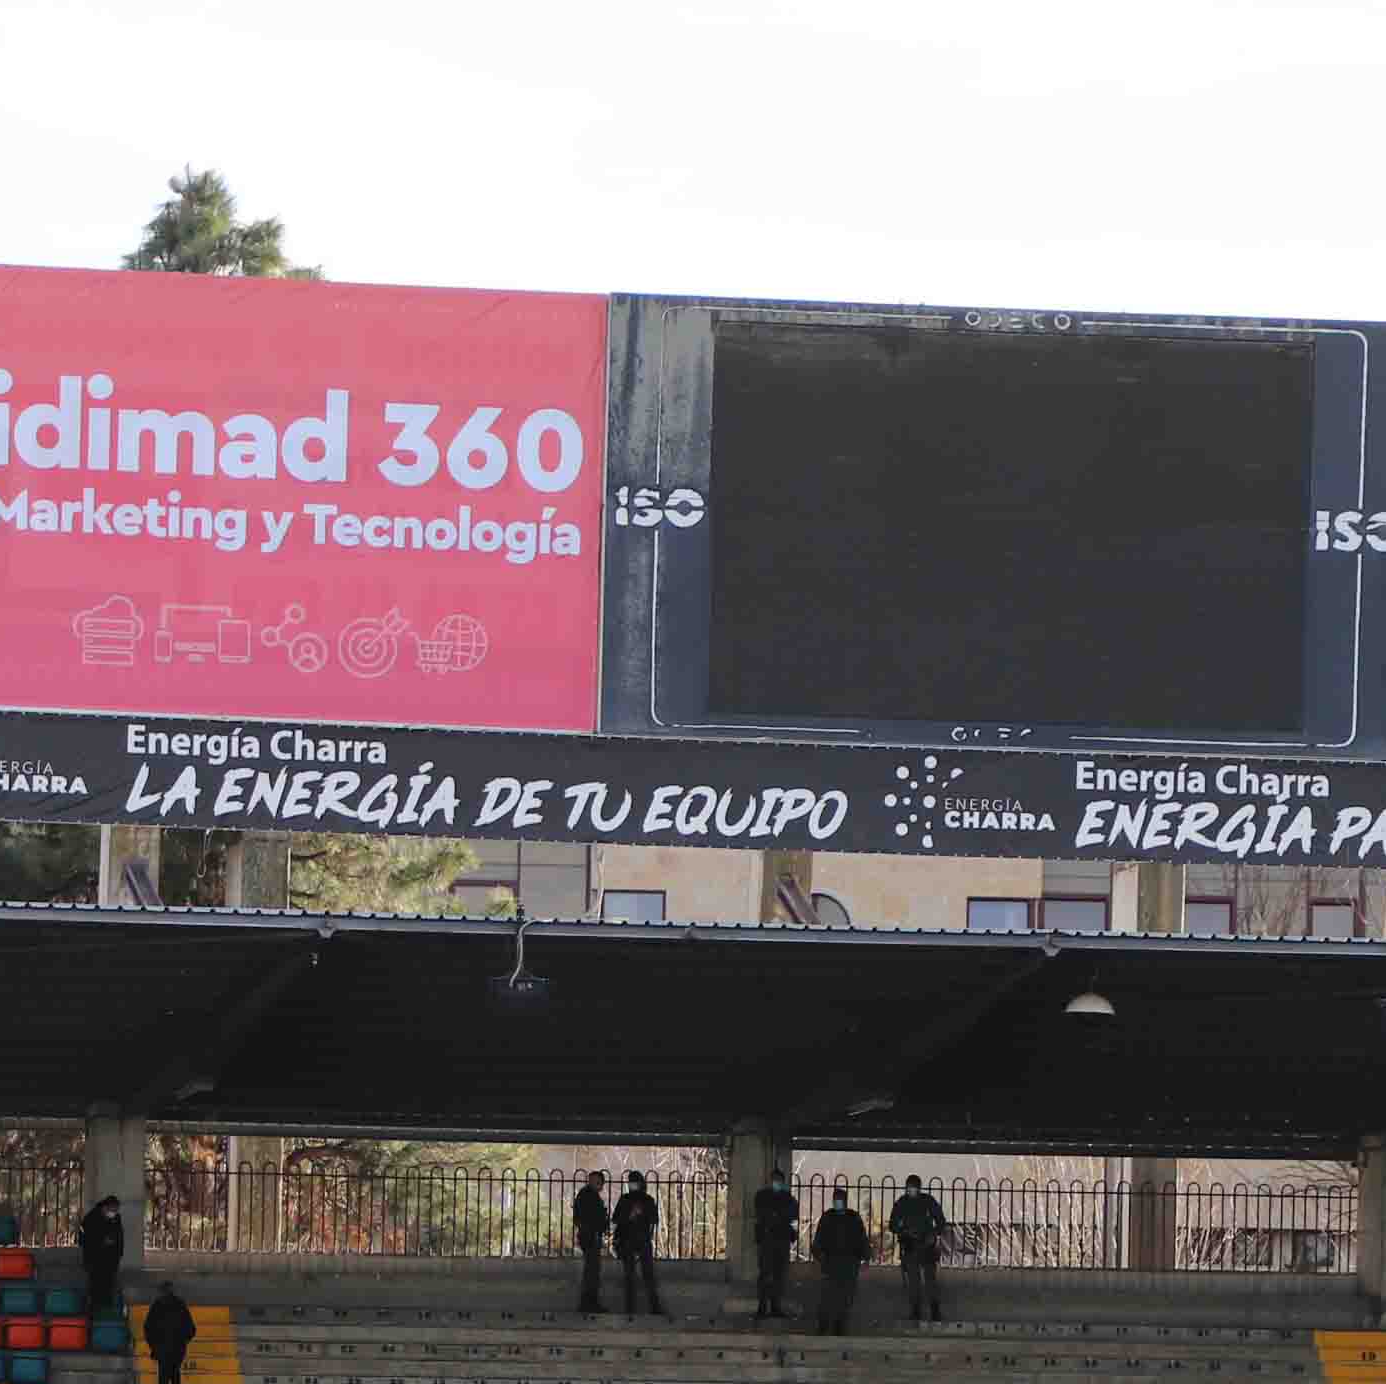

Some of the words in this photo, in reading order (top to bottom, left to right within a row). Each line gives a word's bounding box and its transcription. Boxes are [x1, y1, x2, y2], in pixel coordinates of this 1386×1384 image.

[377, 403, 583, 493] 360
[260, 511, 293, 553] y
[304, 502, 581, 564] Tecnología
[126, 724, 261, 765] Energía
[270, 729, 387, 763] Charra
[124, 761, 201, 815] LA
[213, 762, 460, 829] ENERGÍA
[473, 777, 554, 828] DE
[564, 781, 632, 834] TU
[643, 784, 848, 840] EQUIPO
[944, 796, 1023, 812] ENERGÍA
[1075, 760, 1206, 800] Energía
[1215, 764, 1330, 797] Charra
[944, 810, 1056, 831] CHARRA
[1075, 797, 1315, 859] ENERGÍA
